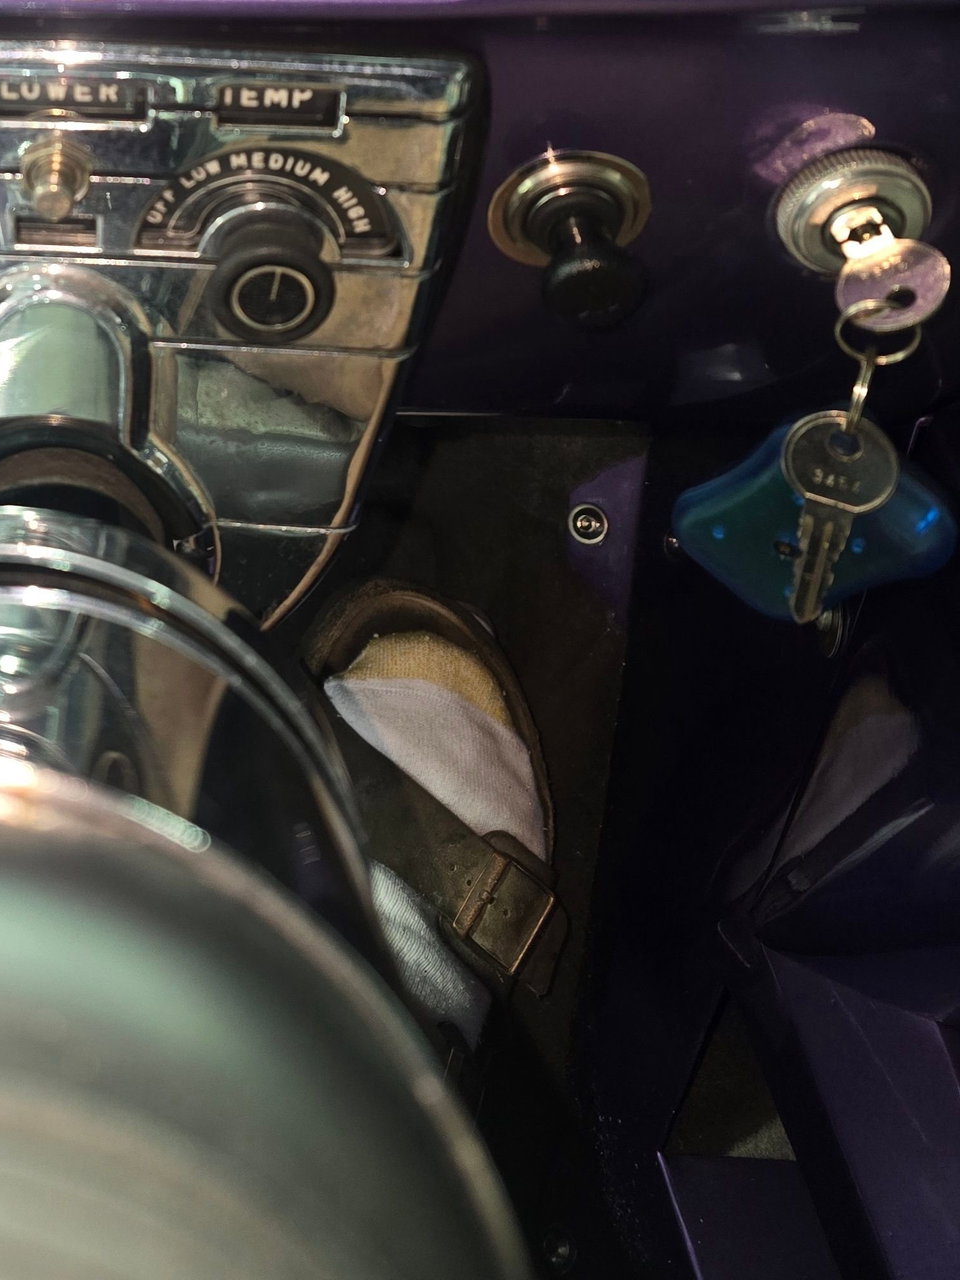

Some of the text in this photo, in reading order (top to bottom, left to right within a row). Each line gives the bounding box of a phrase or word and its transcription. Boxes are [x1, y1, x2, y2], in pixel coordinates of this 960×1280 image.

[222, 87, 314, 109] TEMP
[146, 151, 372, 234] OFF LOW MEDIUM HIGH
